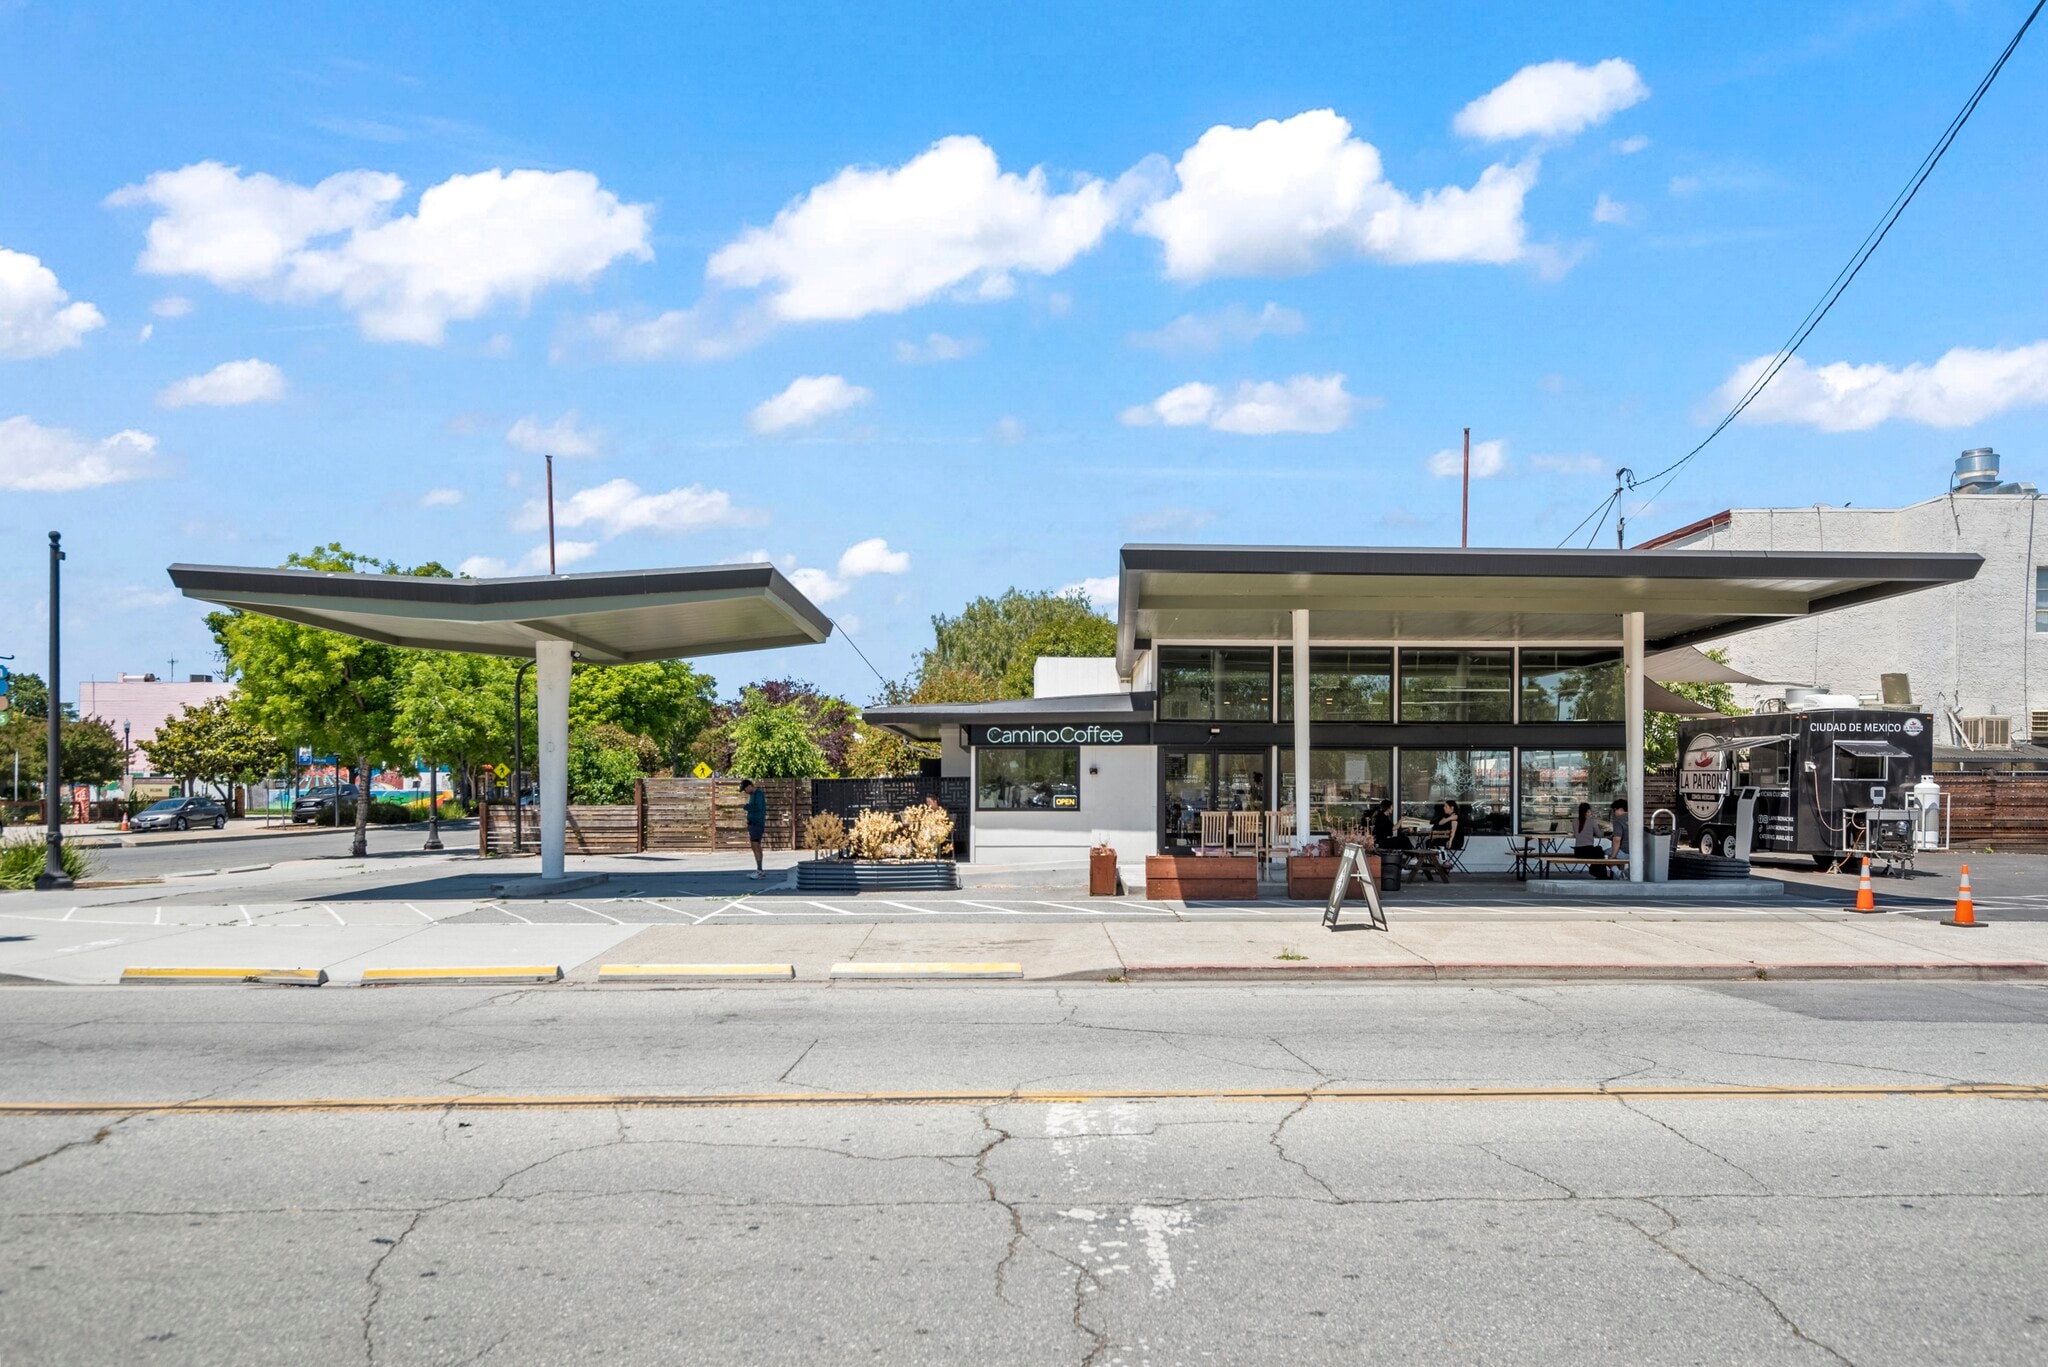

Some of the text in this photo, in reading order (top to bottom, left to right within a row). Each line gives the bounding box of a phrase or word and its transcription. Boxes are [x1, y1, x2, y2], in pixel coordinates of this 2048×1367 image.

[1809, 722, 1901, 733] CIUDAD DE MEXICO
[1680, 772, 1728, 791] LA PATRONA
[1055, 797, 1076, 807] OPEN
